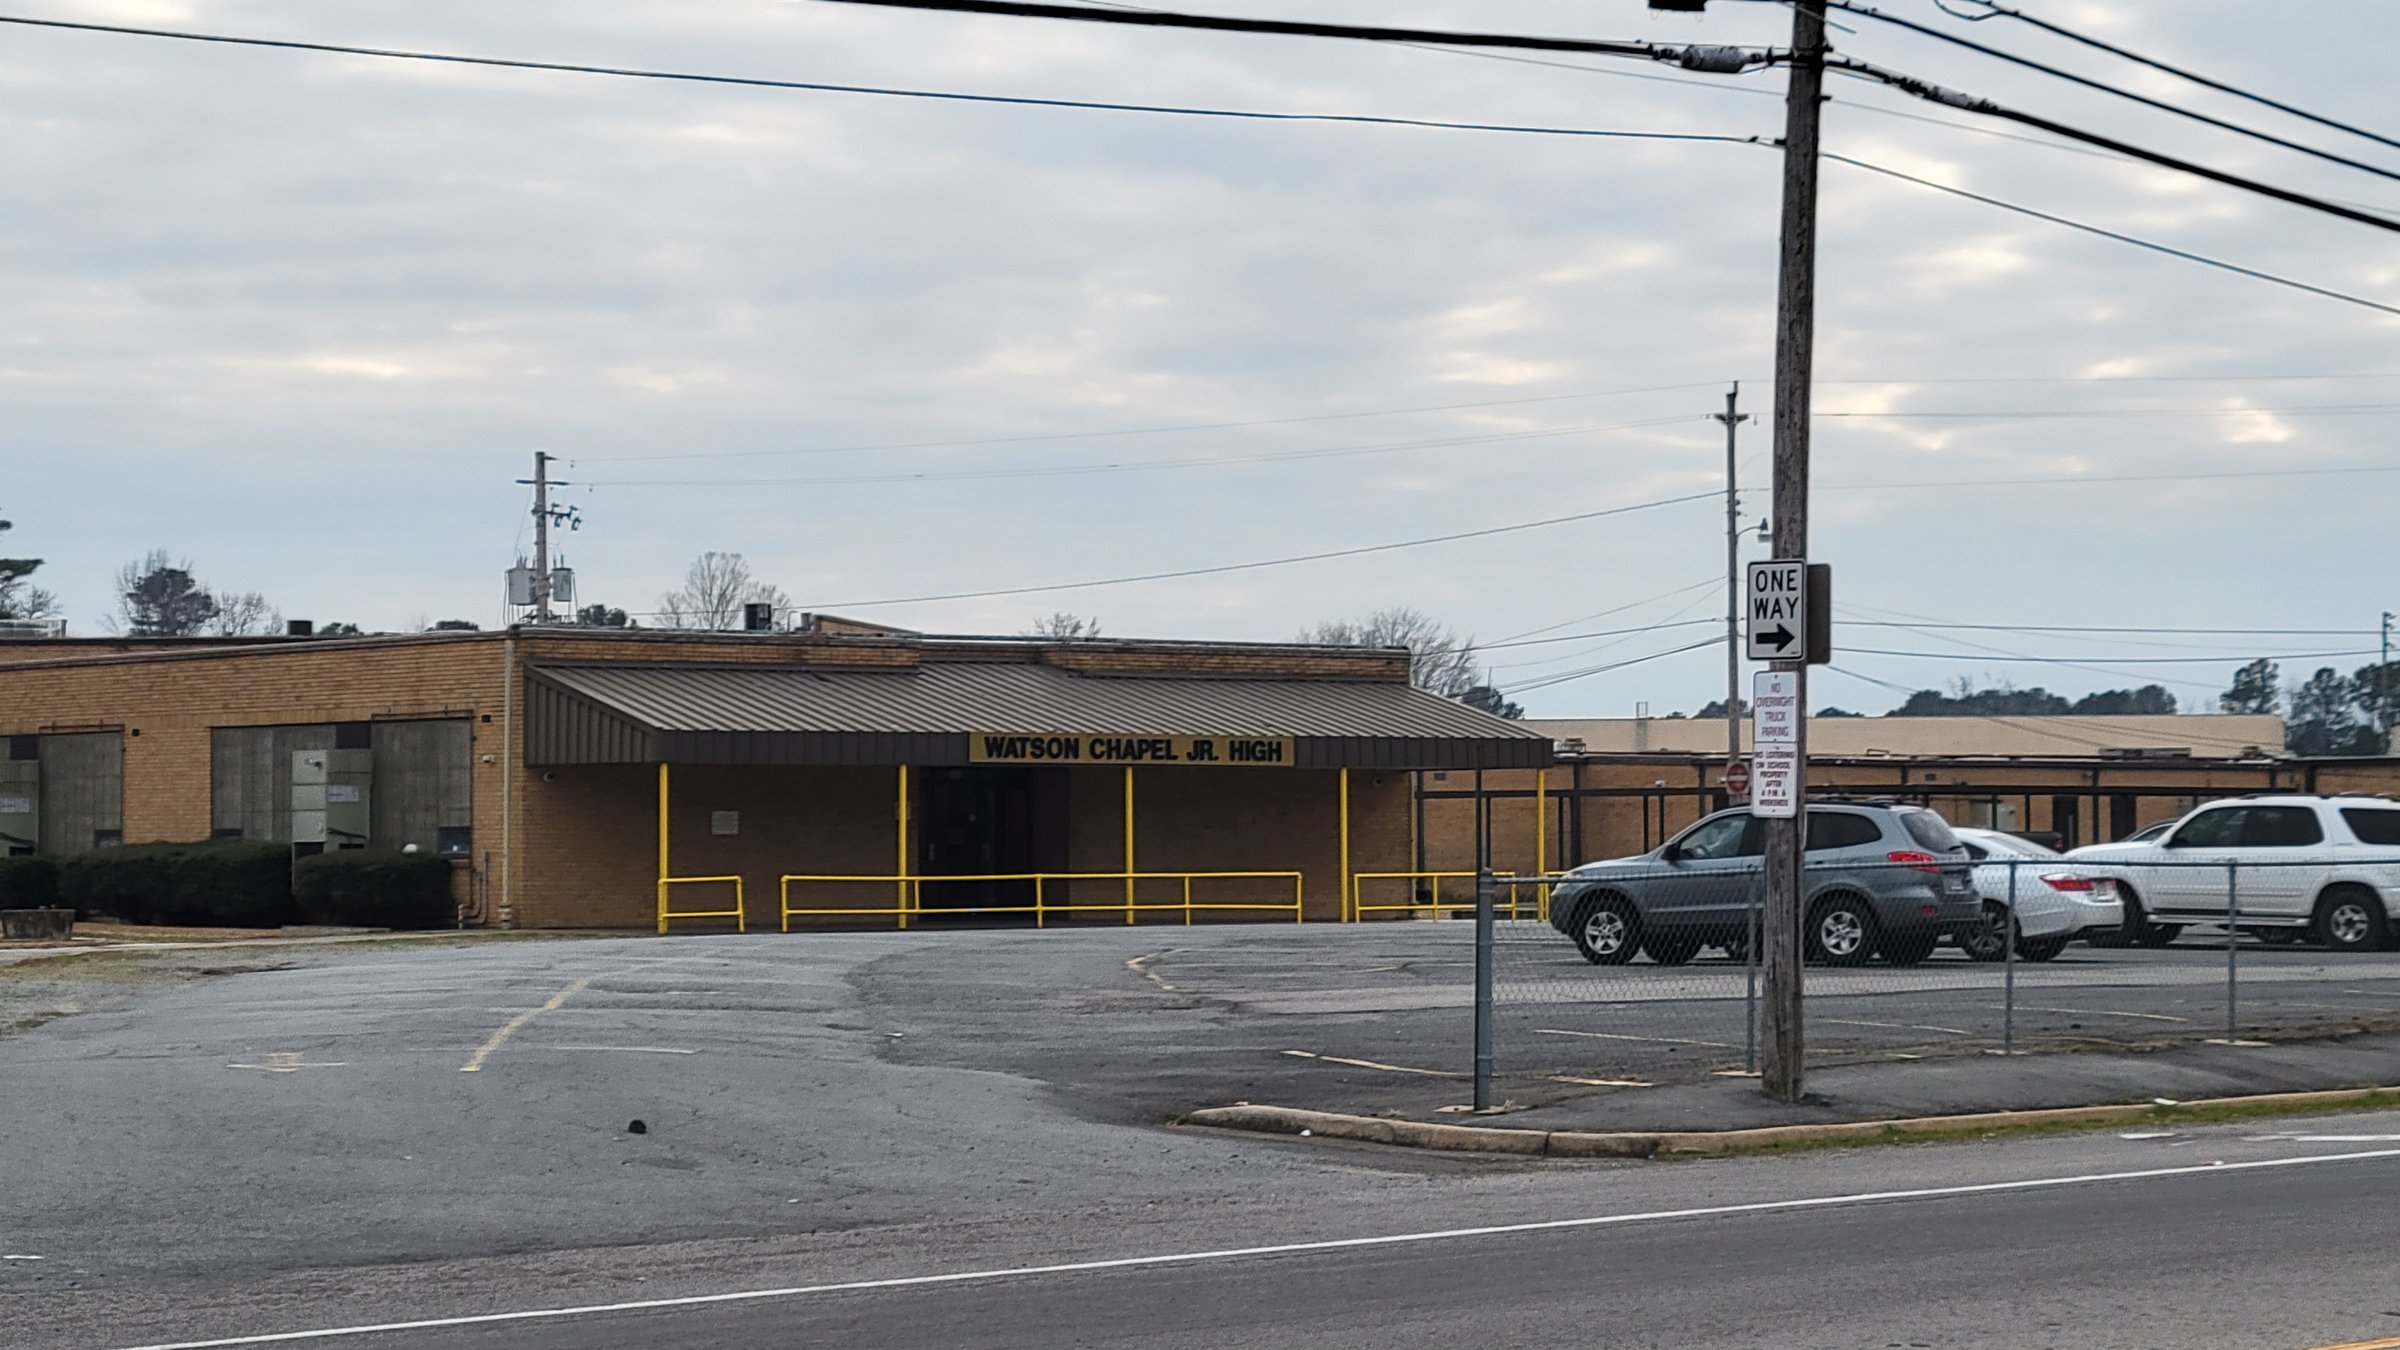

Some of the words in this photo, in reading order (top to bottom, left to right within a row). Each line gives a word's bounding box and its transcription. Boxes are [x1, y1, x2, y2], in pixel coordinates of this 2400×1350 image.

[1755, 569, 1798, 592] ONE
[1753, 596, 1799, 620] WAY
[1771, 683, 1781, 693] NO
[1756, 696, 1795, 708] OVERNIGHT
[1764, 711, 1786, 721] TRUCK
[1761, 726, 1789, 737] PARKING
[984, 736, 1079, 759] WATSON
[1089, 738, 1179, 761] CHAPEL
[1186, 741, 1219, 762] JR.
[1230, 741, 1282, 762] HIGH
[1754, 751, 1764, 759] NO
[1765, 751, 1795, 759] LOITERING
[1759, 799, 1788, 807] WEEKENDS
